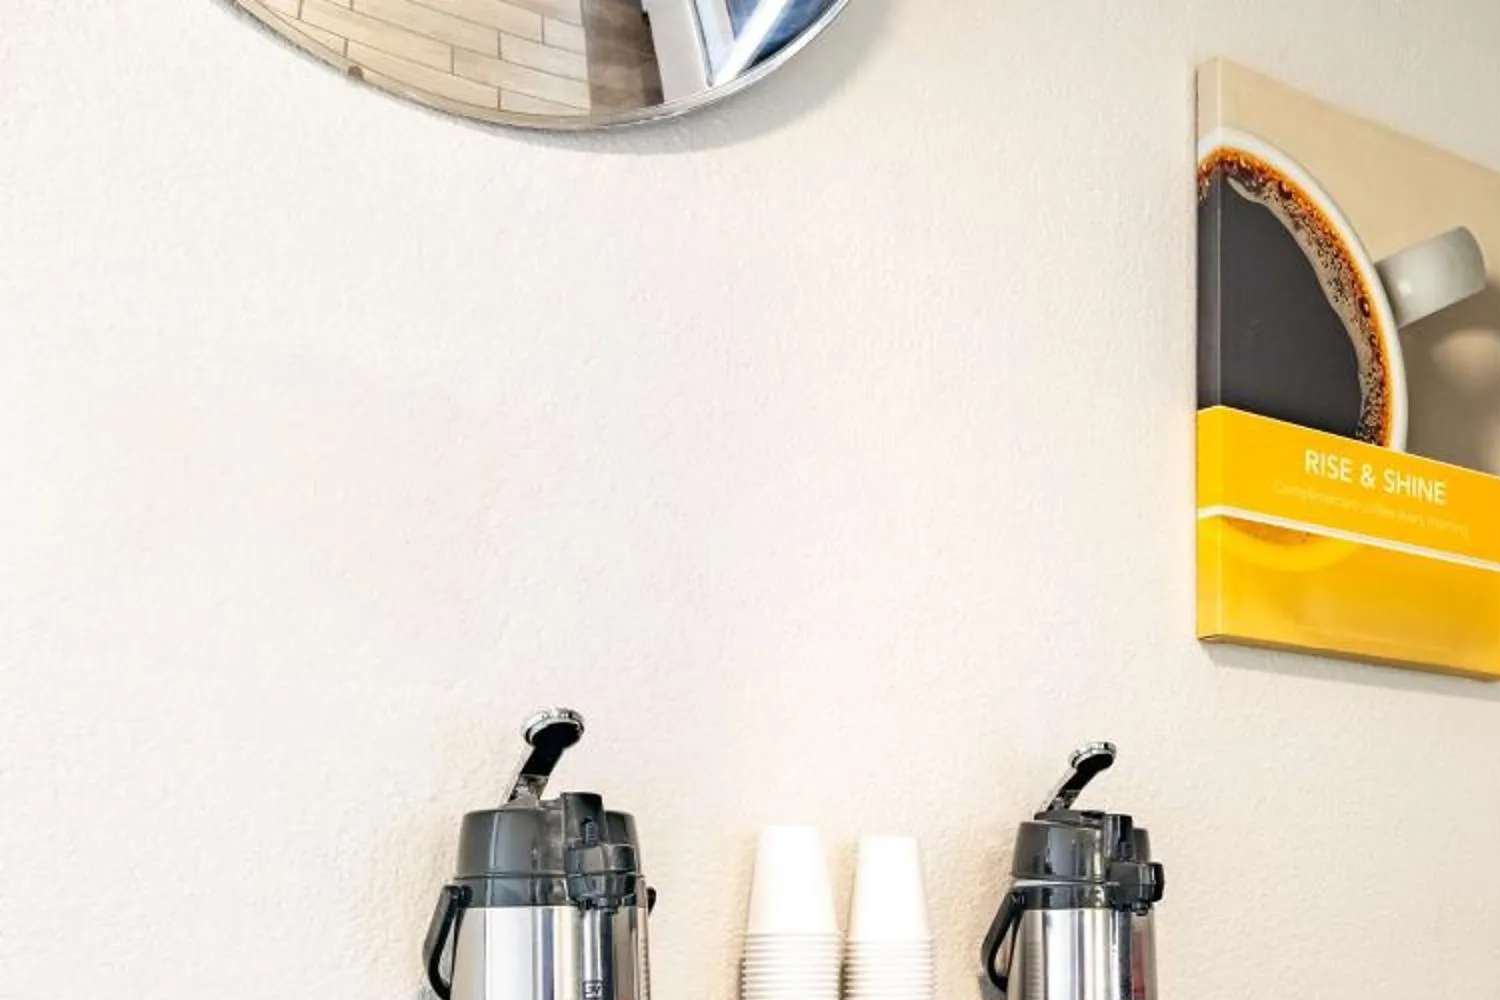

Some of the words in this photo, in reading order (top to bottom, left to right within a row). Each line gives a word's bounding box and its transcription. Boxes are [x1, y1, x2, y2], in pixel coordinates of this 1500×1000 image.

[1304, 449, 1352, 483] RISE
[1360, 463, 1376, 490] &
[1383, 469, 1446, 505] SHINE
